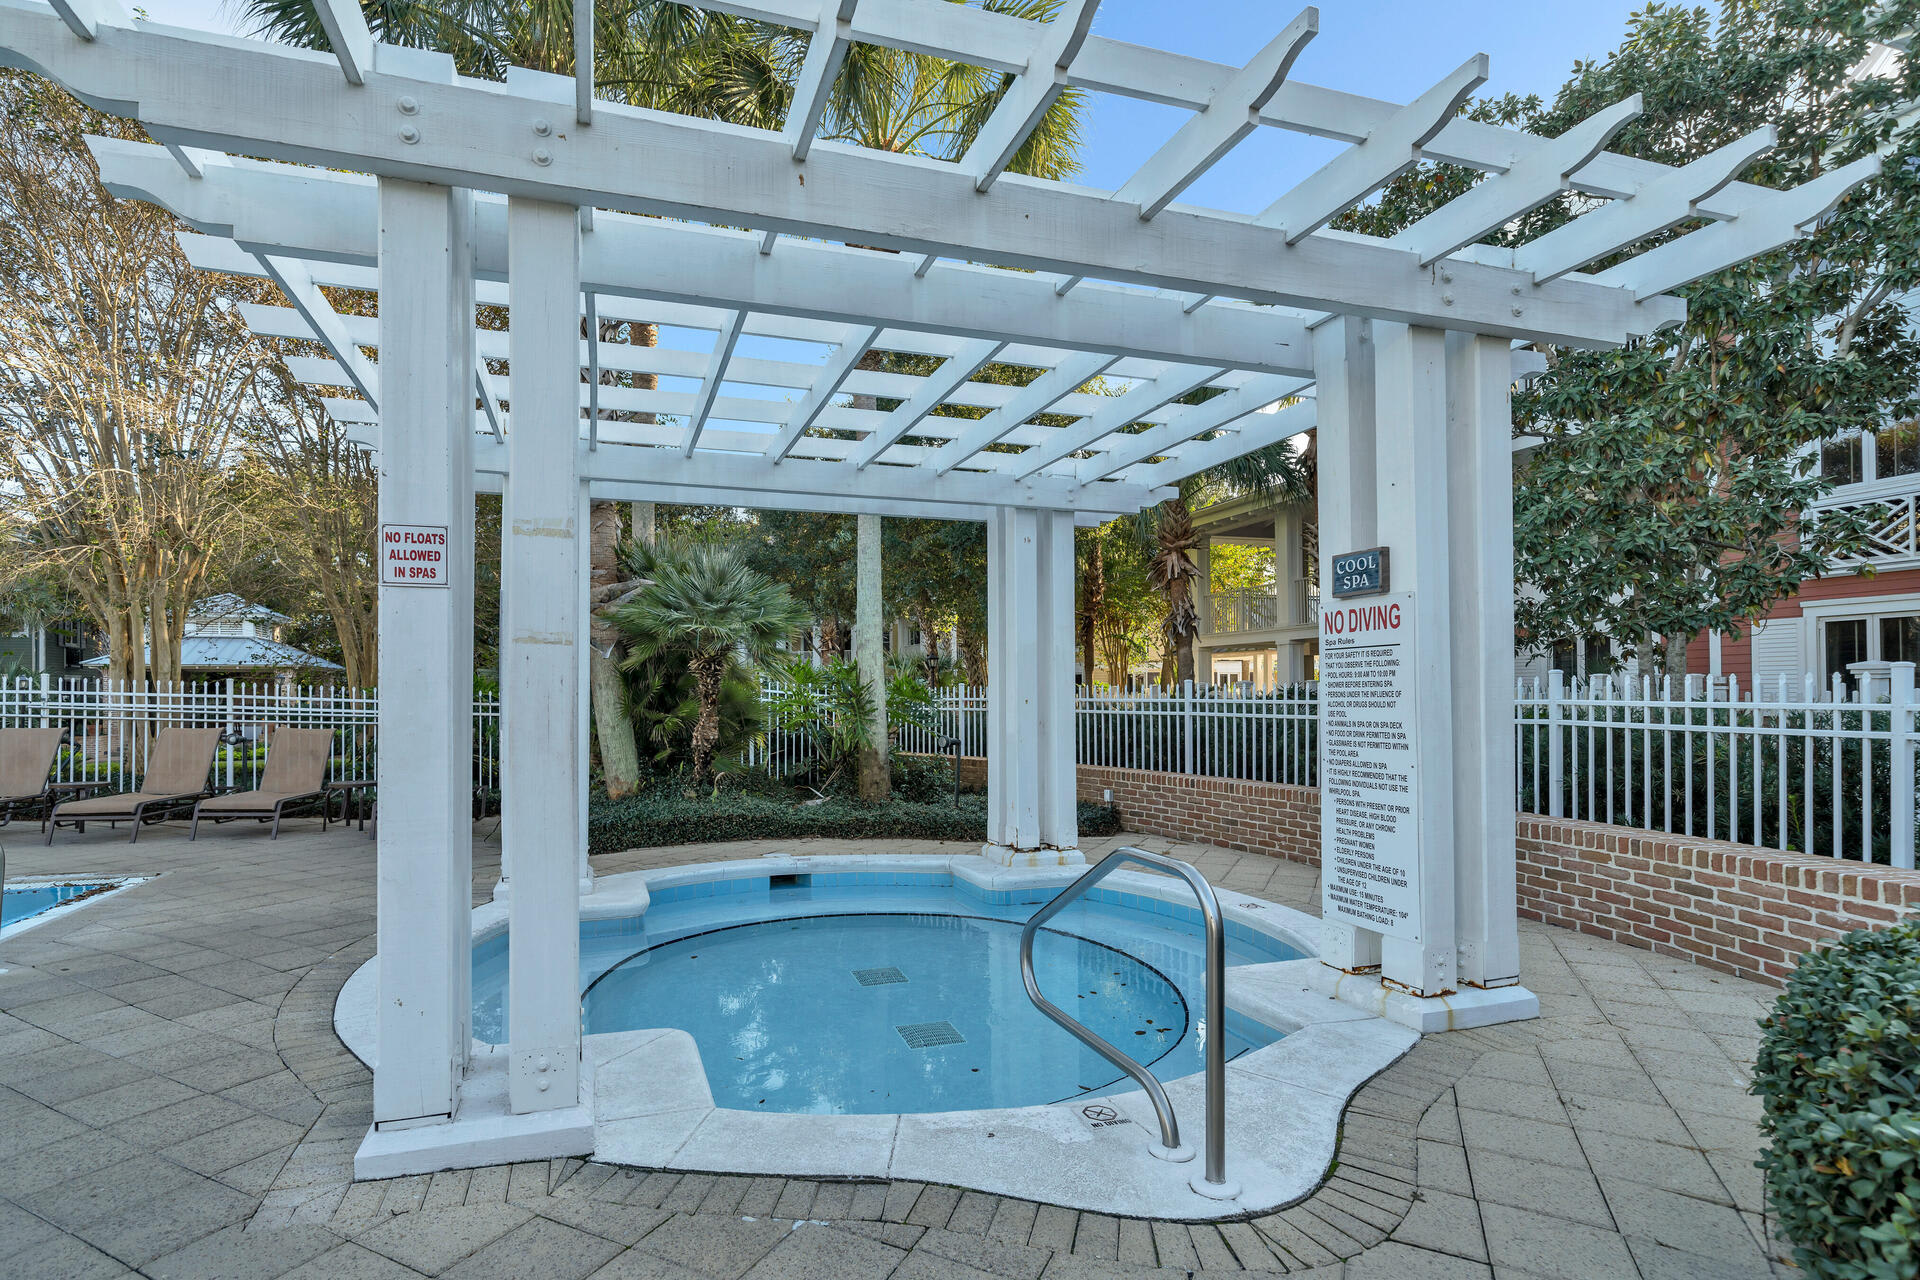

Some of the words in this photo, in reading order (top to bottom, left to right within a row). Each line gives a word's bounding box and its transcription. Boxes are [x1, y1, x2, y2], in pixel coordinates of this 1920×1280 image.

[385, 532, 401, 543] NO
[405, 532, 445, 544] FLOATS
[390, 549, 440, 561] ALLOWED
[1337, 555, 1376, 574] COOL
[395, 567, 405, 577] IN
[409, 567, 436, 578] SPAS
[1344, 574, 1369, 589] SPA
[1325, 610, 1344, 635] NO
[1349, 604, 1400, 632] DIVING
[1371, 649, 1393, 657] REQUIRED
[1352, 771, 1385, 780] RECOMMENDED
[1329, 778, 1351, 786] FOLLOWING
[1352, 780, 1377, 789] INDIVIDUALS
[1389, 784, 1398, 792] USE
[1399, 785, 1408, 793] THE
[1329, 788, 1351, 796] WHIRLPOOL
[1336, 798, 1354, 806] PERSONS
[1355, 800, 1366, 808] WITH
[1367, 802, 1386, 810] PRESENT
[1395, 806, 1409, 814] PRIOR
[1381, 814, 1396, 823] BLOOD
[1336, 827, 1351, 836] HEALTH
[1352, 830, 1375, 840] PROBLEMS
[1375, 824, 1396, 833] CHRONIC
[1337, 837, 1358, 846] PREGNANT
[1359, 841, 1375, 850] WOMEN
[1337, 847, 1354, 856] ELDERLY
[1355, 850, 1374, 860] PERSONS
[1337, 857, 1356, 866] CHILDREN
[1358, 861, 1371, 870] UNDER
[1373, 864, 1381, 872] THE
[1382, 866, 1391, 874] AGE
[1337, 866, 1367, 879] UNSUPERVISED
[1368, 874, 1390, 884] CHILDREN
[1391, 879, 1407, 888] UNDER
[1346, 878, 1354, 886] AGE
[1330, 884, 1348, 894] MAXIMUM
[1349, 888, 1358, 896] USE:
[1365, 893, 1383, 903] MINUTES
[1330, 893, 1348, 904] MAXIMUM
[1349, 898, 1363, 908] WATER
[1364, 902, 1397, 917] TEMPERATURE:
[1338, 905, 1356, 916] MAXIMUM
[1357, 910, 1375, 921] BATHING
[1376, 916, 1390, 925] LOAD:
